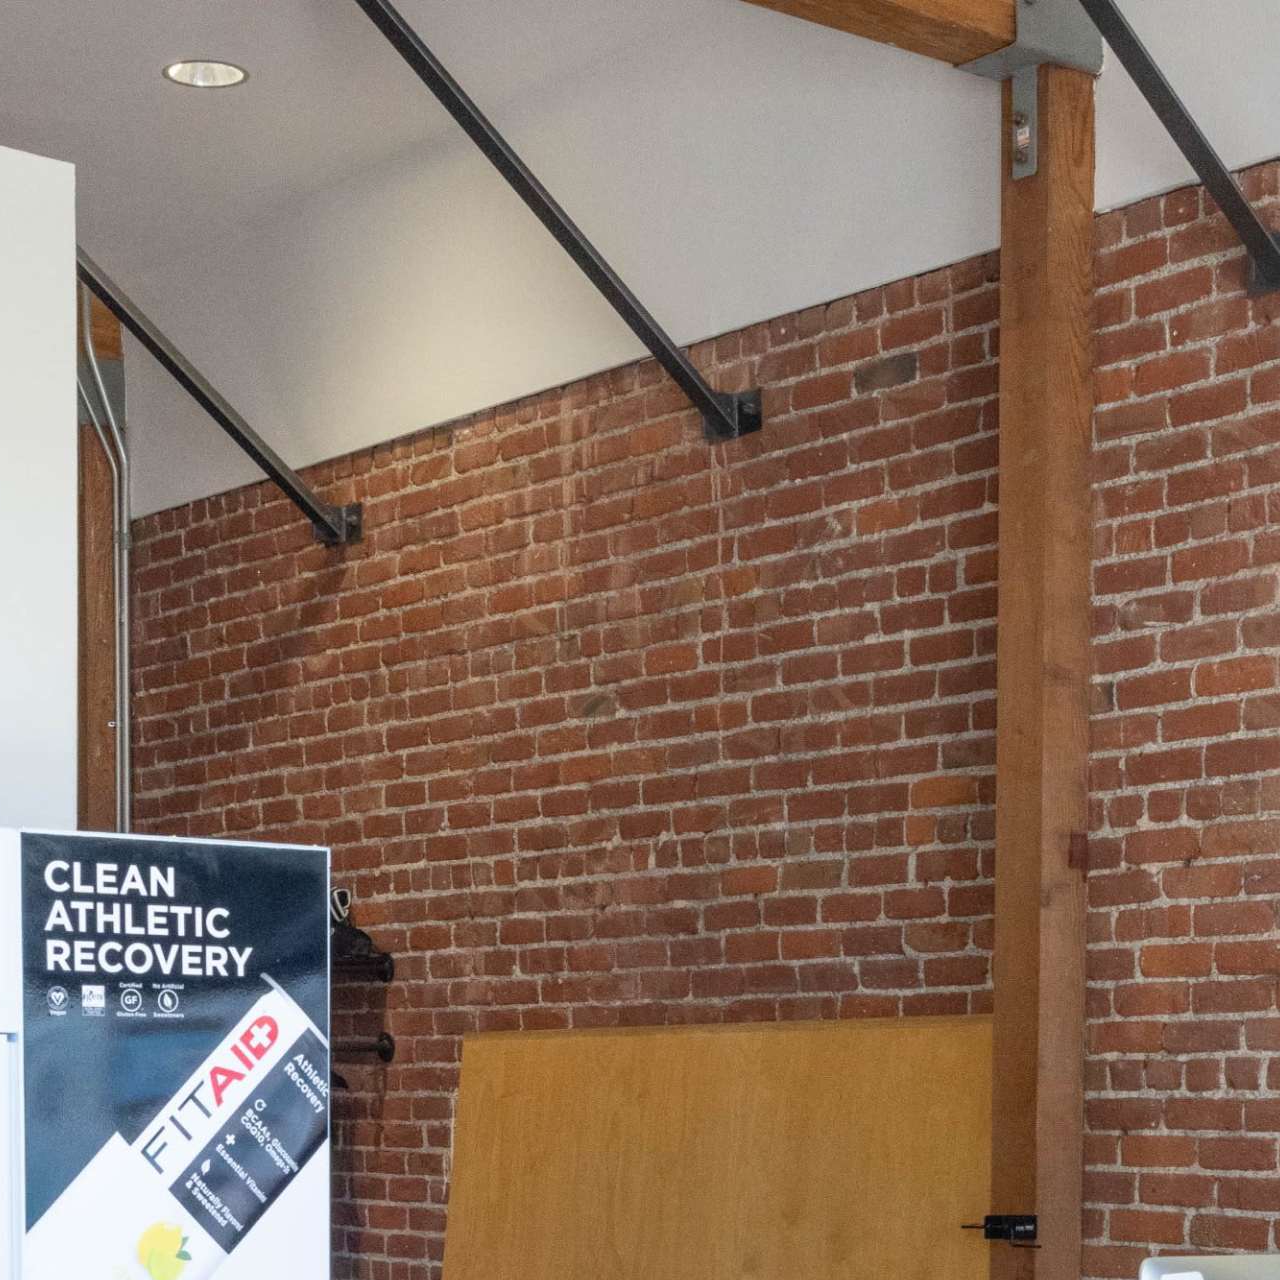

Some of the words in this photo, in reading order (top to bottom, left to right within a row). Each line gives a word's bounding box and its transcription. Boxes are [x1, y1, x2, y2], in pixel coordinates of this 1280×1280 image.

[43, 859, 176, 898] CLEAN
[44, 900, 231, 939] ATHLETIC
[45, 940, 254, 978] RECOVERY
[125, 996, 138, 1005] GF
[140, 1015, 279, 1175] FITAID
[284, 1062, 325, 1113] Recovery
[293, 1053, 329, 1098] Athletic
[216, 1143, 248, 1182] Essential
[189, 1173, 223, 1210] Naturally
